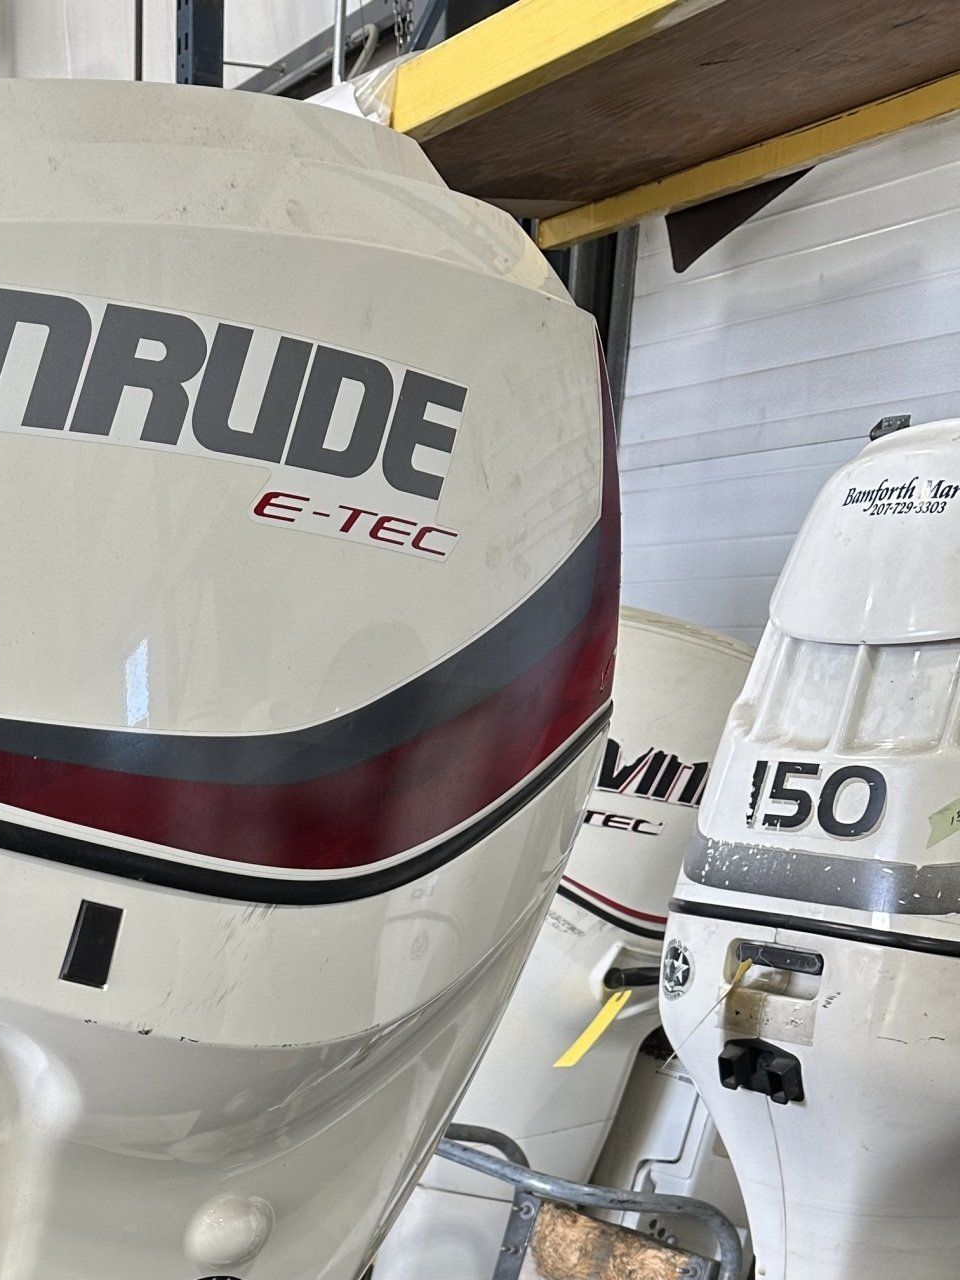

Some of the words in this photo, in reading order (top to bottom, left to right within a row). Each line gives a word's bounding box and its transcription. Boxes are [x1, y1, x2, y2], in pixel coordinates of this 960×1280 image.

[841, 475, 920, 513] Bamforth
[869, 500, 948, 517] 207-729-3303
[253, 490, 461, 557] E-TEC
[745, 759, 888, 840] 150
